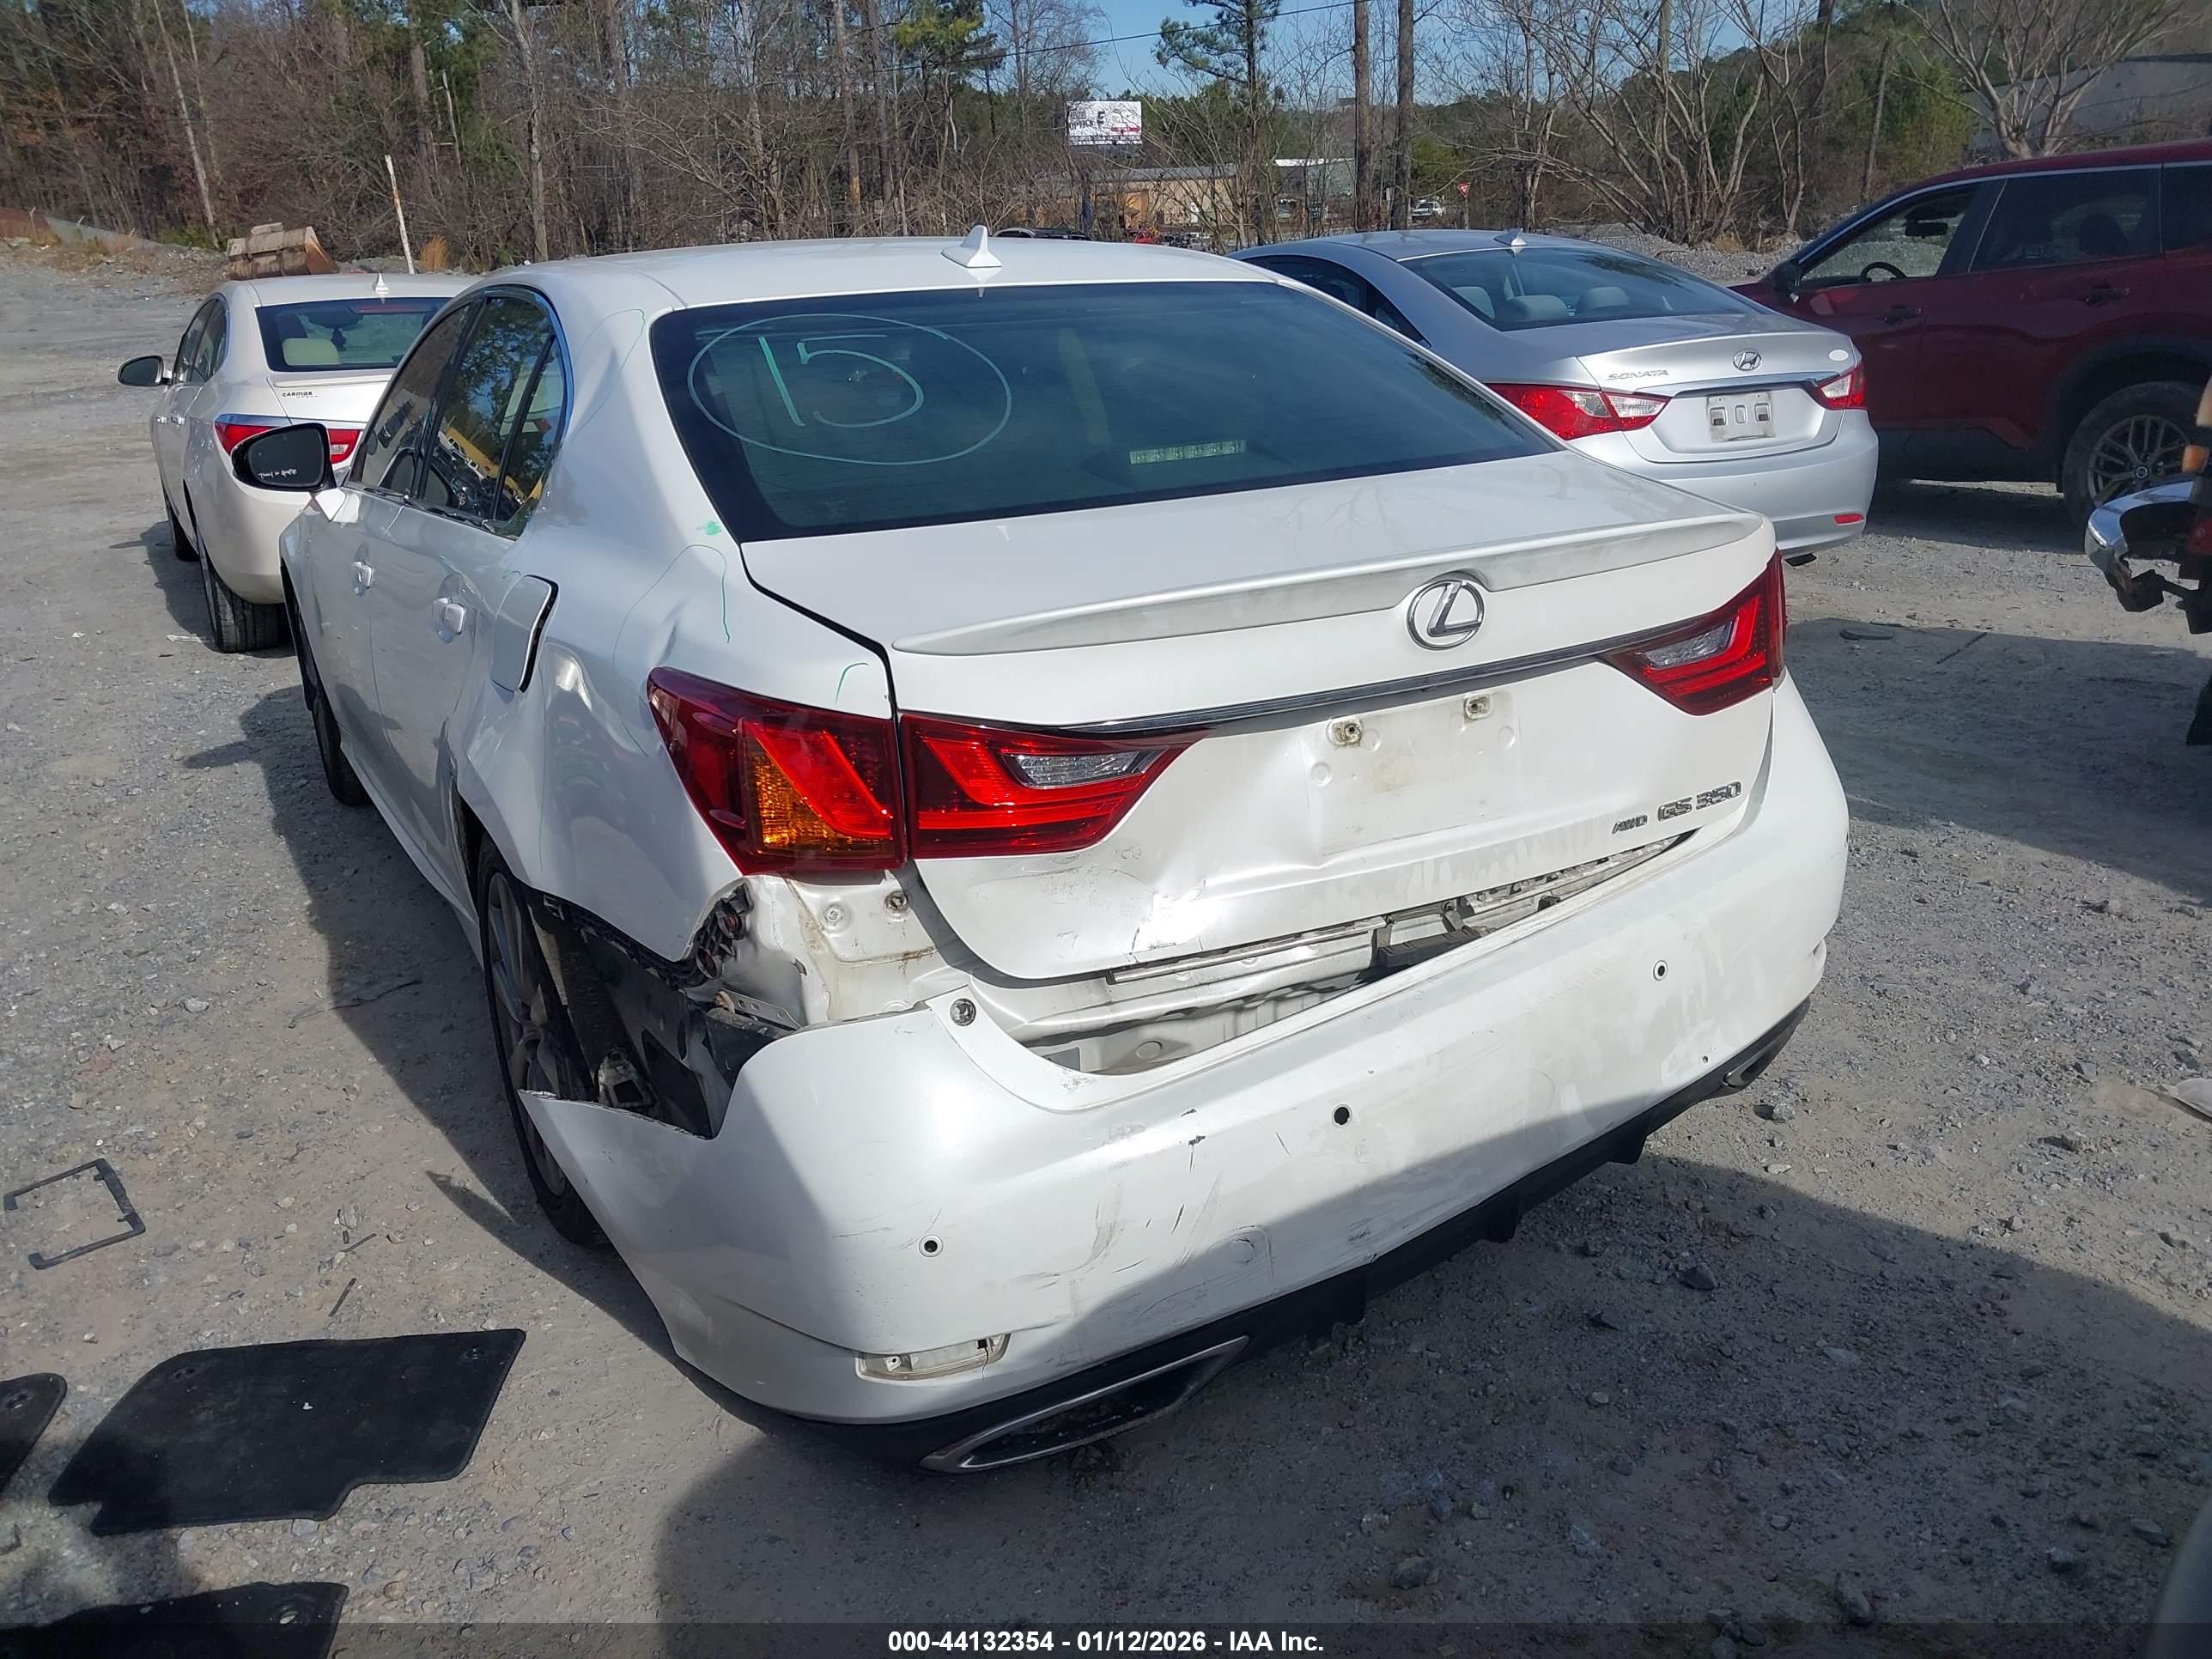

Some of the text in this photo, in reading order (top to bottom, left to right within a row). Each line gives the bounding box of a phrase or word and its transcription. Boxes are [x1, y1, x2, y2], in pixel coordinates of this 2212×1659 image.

[757, 333, 924, 428] 15
[1607, 368, 1669, 381] SONATA
[1611, 781, 1742, 835] AWD GS 350
